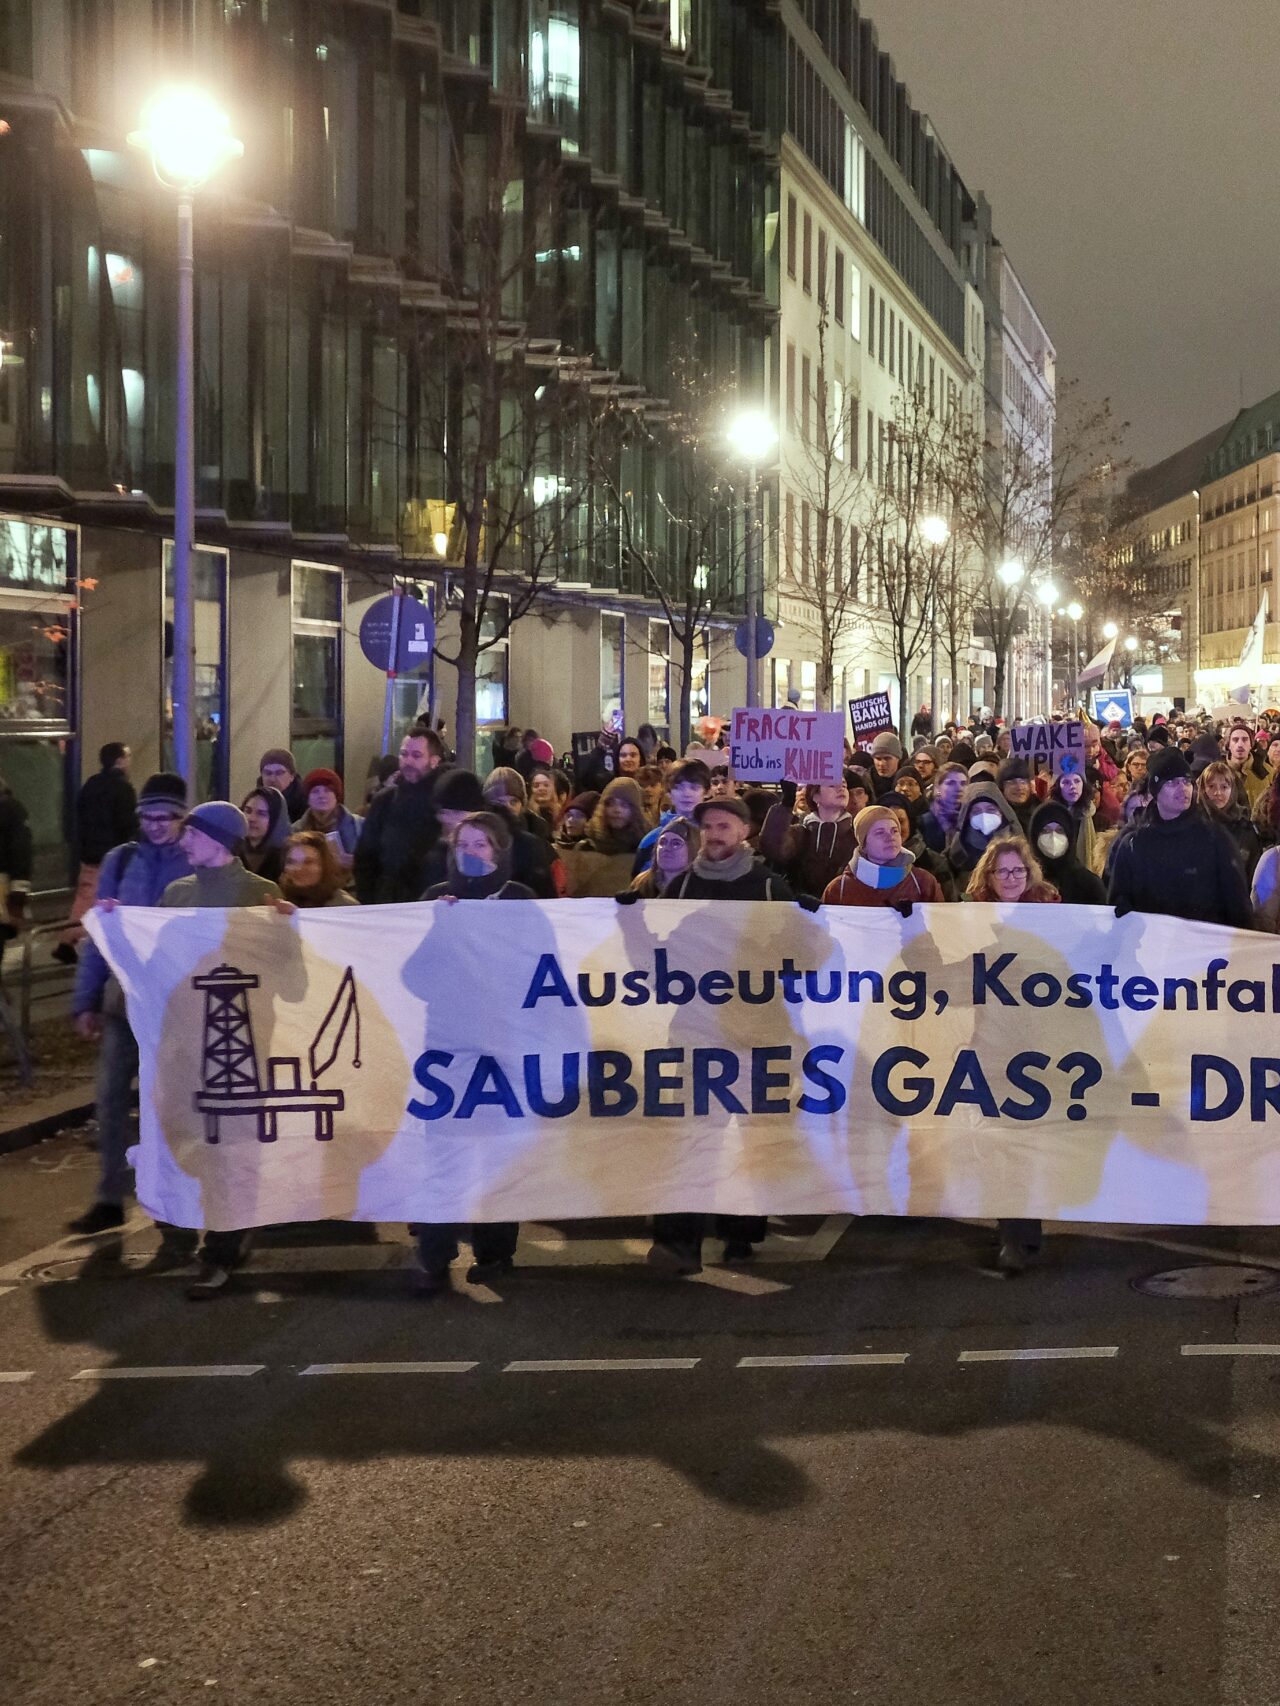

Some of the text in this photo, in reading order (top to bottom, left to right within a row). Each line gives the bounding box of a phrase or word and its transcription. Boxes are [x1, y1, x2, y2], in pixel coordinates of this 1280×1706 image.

[851, 695, 888, 711] DEUTSCHE
[852, 702, 890, 724] BANK
[735, 711, 818, 742] FRACKT
[855, 716, 890, 732] HANDS OFF
[1010, 722, 1083, 752] WAKE
[731, 746, 834, 781] Euch ins KNIE
[522, 947, 950, 1021] Ausbeutung,
[406, 1044, 847, 1120] SAUBERES
[870, 1045, 1104, 1122] GAS?
[1131, 1092, 1161, 1107] -
